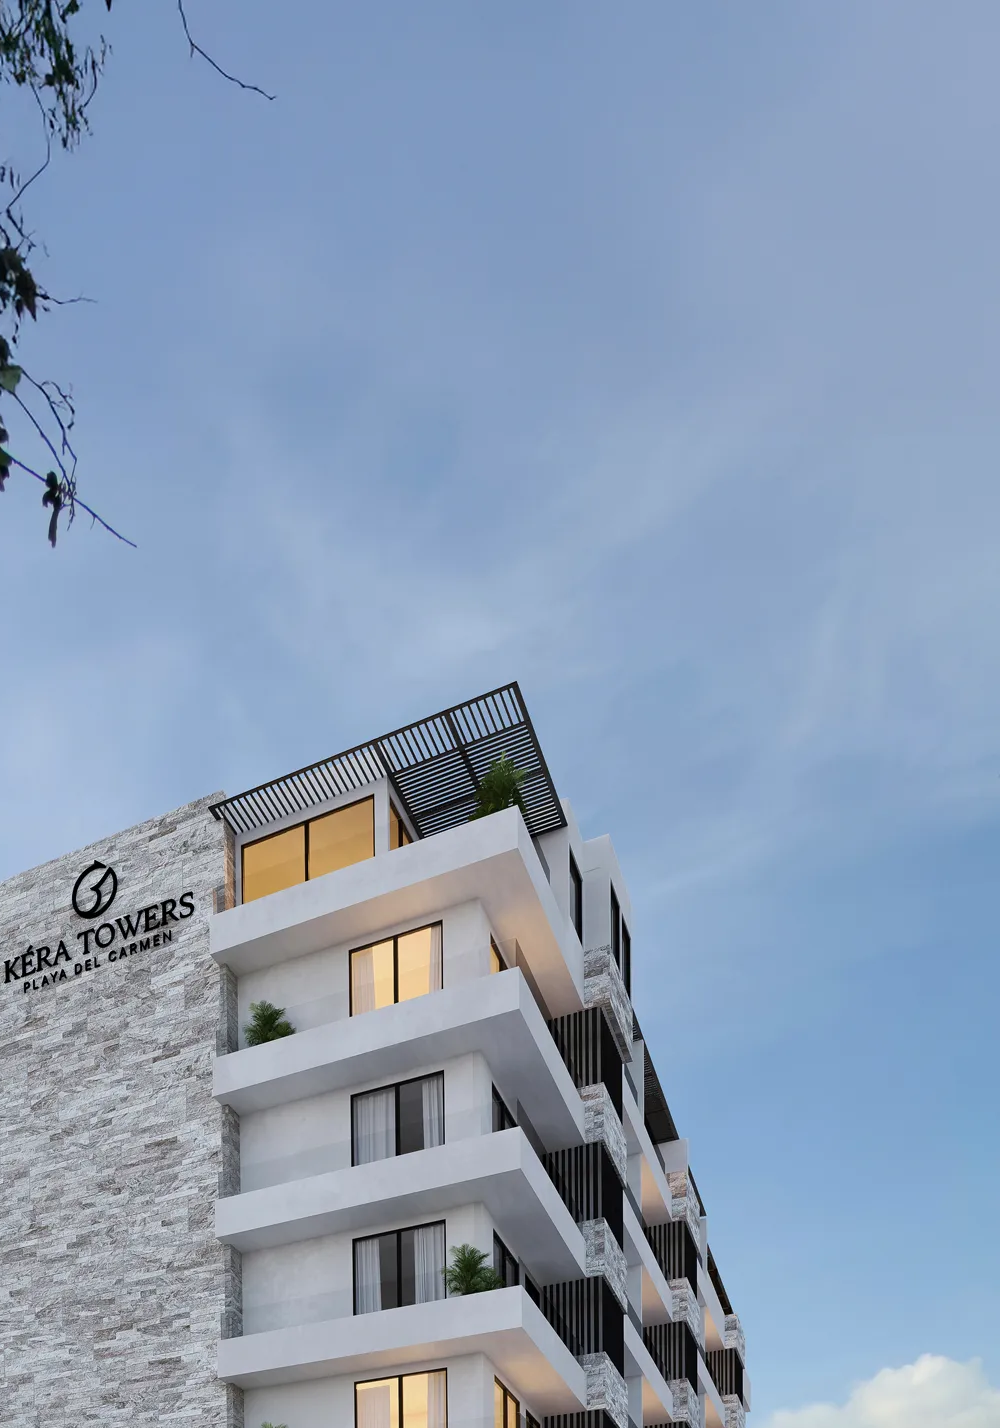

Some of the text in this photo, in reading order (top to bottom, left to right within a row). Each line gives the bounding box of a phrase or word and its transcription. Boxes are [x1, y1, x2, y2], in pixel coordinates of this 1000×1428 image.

[3, 891, 195, 984] KÉRA TOWERS
[22, 929, 172, 994] PLAYA DEL CARMEN
